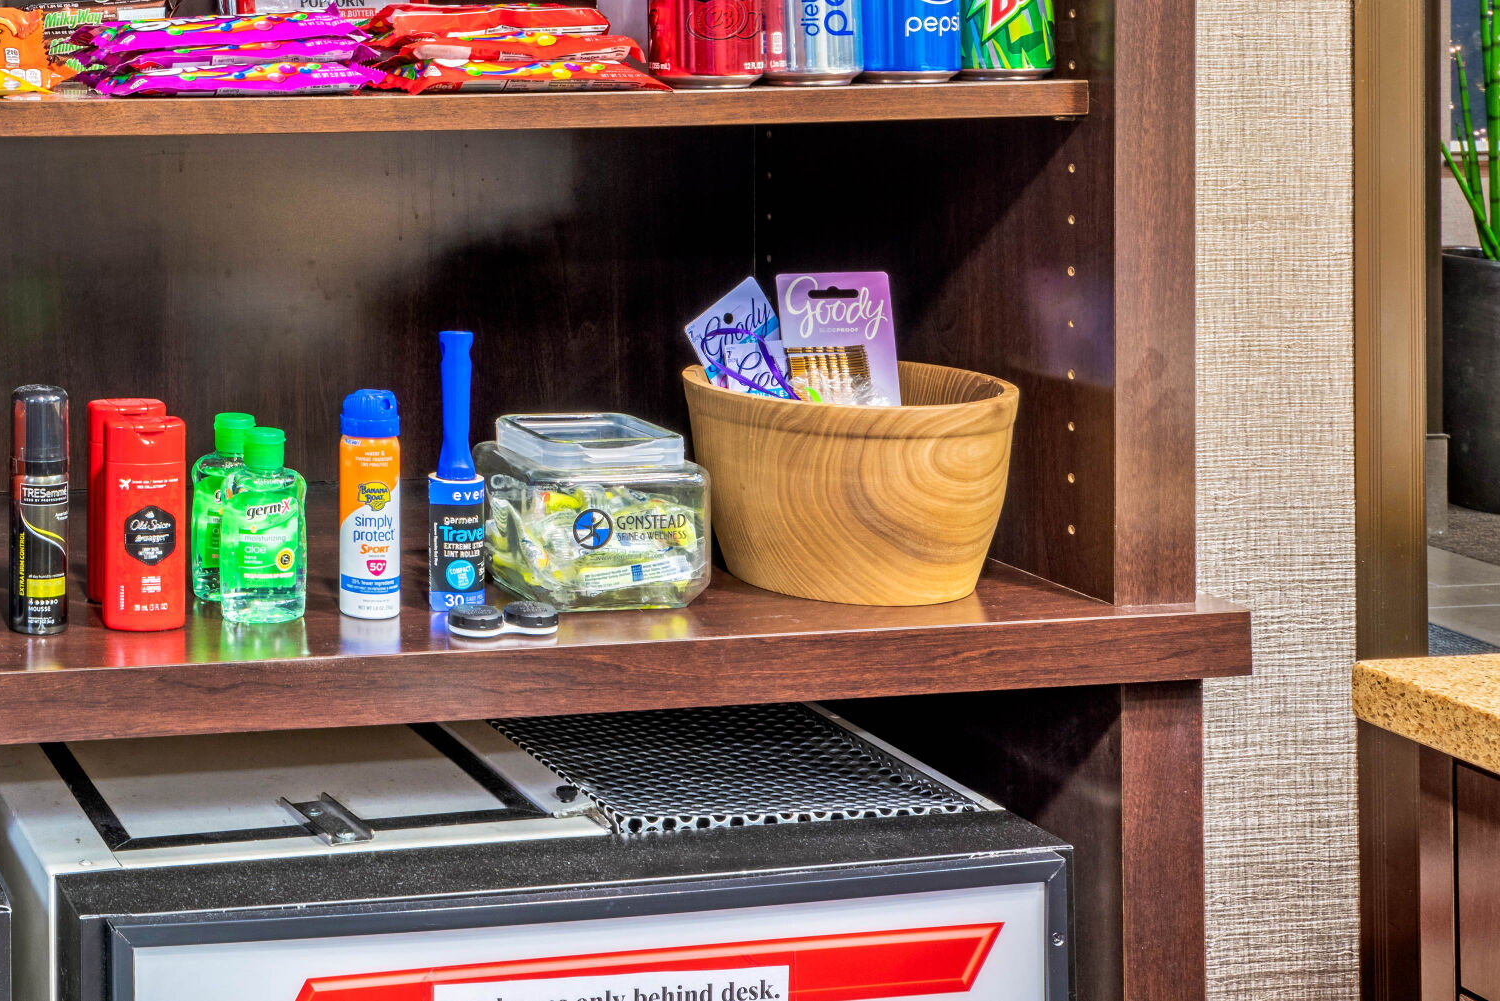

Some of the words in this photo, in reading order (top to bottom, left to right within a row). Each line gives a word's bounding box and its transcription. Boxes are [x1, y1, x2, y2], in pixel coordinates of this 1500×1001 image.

[347, 9, 375, 18] BUTTER
[905, 13, 960, 37] pepsi
[785, 276, 889, 340] Goody
[359, 484, 389, 496] BANANA
[364, 494, 384, 504] BOAT
[130, 519, 150, 531] Old
[150, 520, 171, 532] Spice
[355, 514, 392, 530] simply
[444, 516, 479, 526] garment
[616, 514, 686, 530] GONSTEAD
[244, 534, 286, 542] moisturizing
[353, 528, 395, 544] protect
[438, 525, 484, 543] Travel
[244, 546, 267, 554] aloe
[360, 544, 390, 554] SPORT
[445, 594, 464, 608] 30
[634, 983, 714, 1001] behind
[722, 980, 780, 1001] desk.
